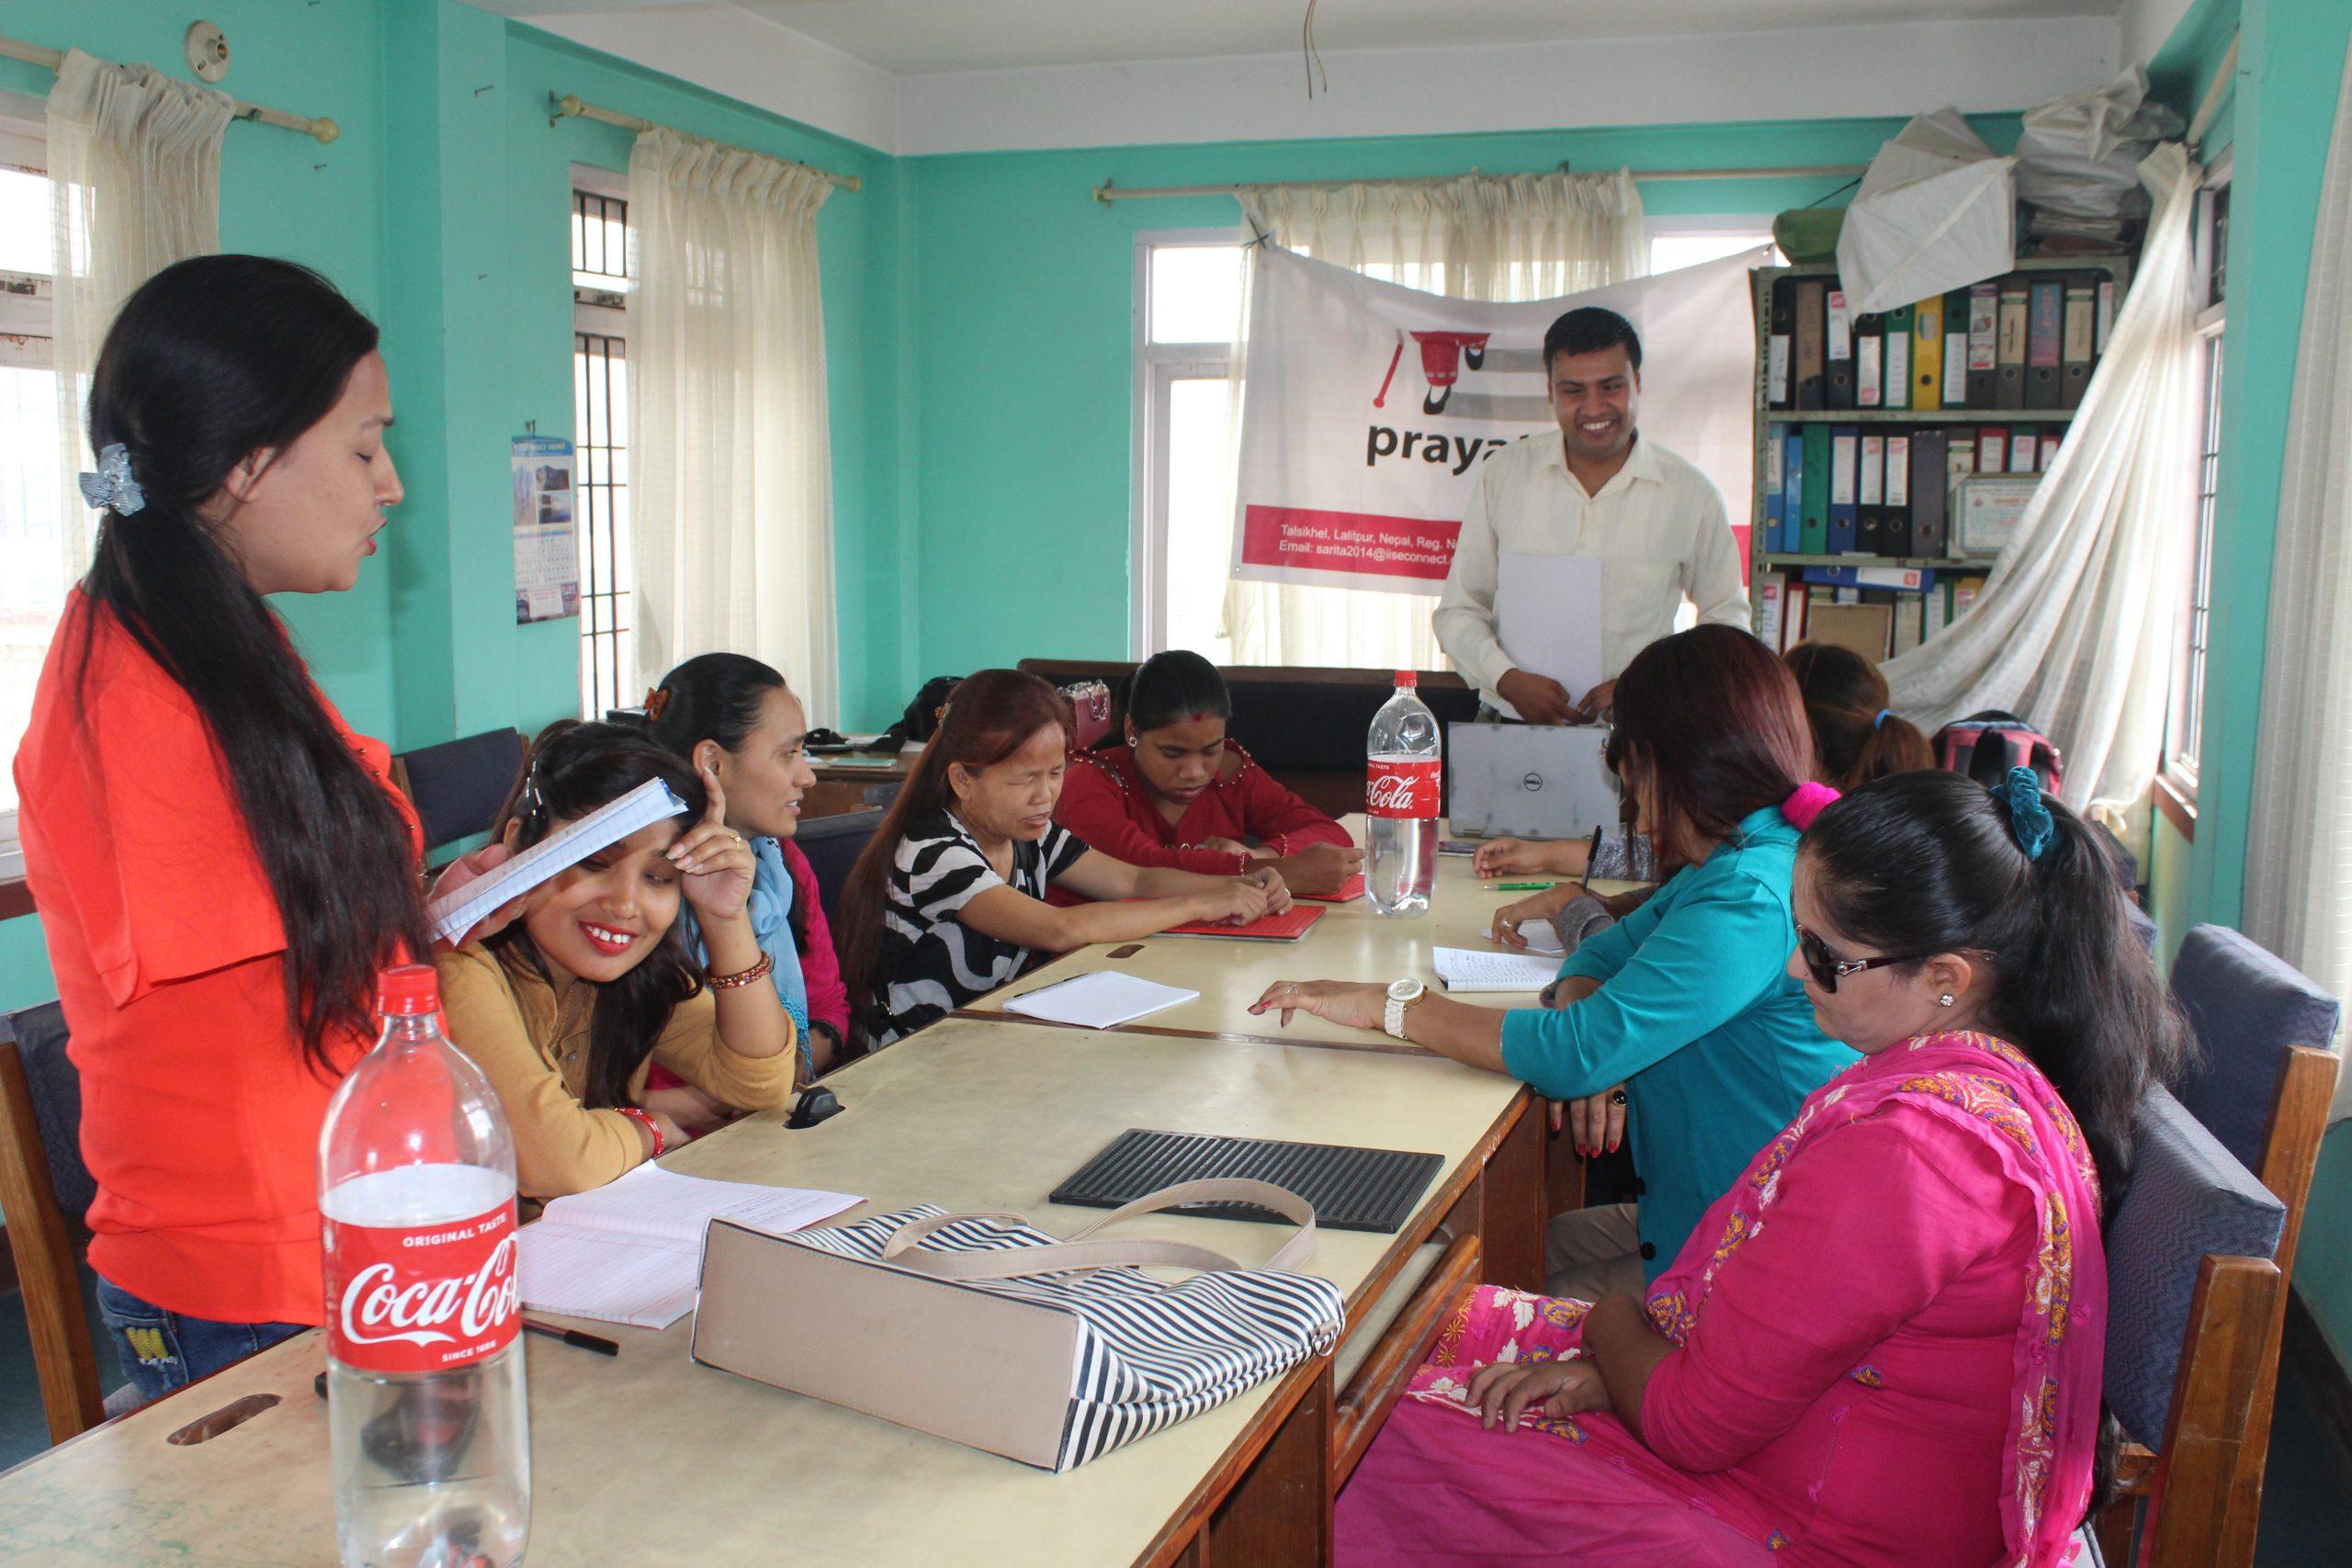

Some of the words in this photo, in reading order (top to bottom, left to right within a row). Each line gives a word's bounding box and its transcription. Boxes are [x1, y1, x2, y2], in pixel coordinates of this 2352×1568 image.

[1279, 540, 1314, 553] Email:
[1281, 525, 1330, 540] Talsikhel,
[1334, 529, 1376, 544] Lalitpur,
[1379, 533, 1414, 547] Nepal,
[1417, 536, 1443, 550] Reg.
[1446, 539, 1458, 550] N
[402, 1227, 475, 1247] ORIGINAL
[478, 1213, 507, 1234] TASTE
[341, 1232, 522, 1347] Coca-Col
[442, 1348, 474, 1362] SINCE
